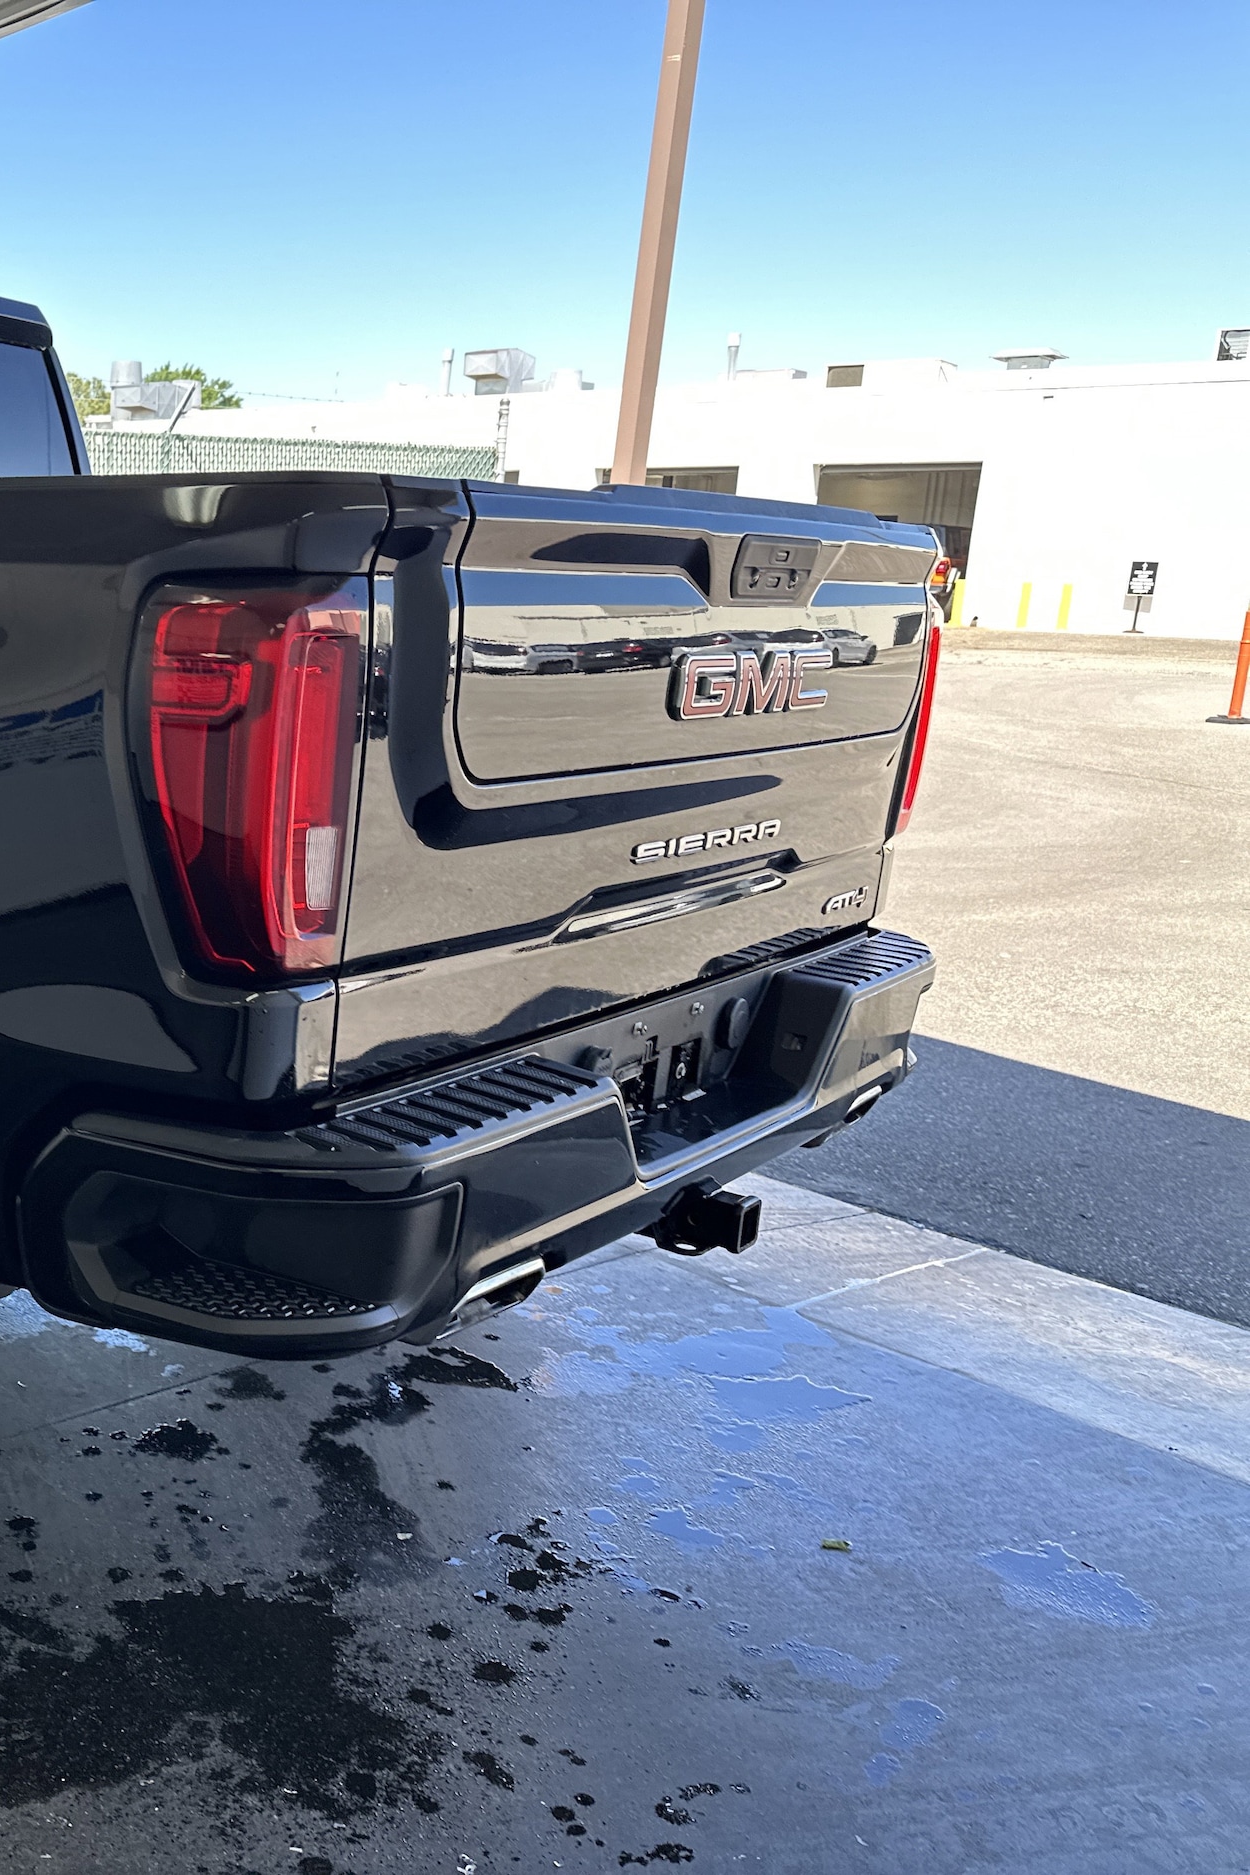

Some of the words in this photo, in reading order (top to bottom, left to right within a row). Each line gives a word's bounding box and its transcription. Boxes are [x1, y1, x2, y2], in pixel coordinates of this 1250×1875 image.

[670, 649, 833, 720] GMC
[630, 818, 781, 864] SIERRA
[822, 886, 868, 914] AT4
